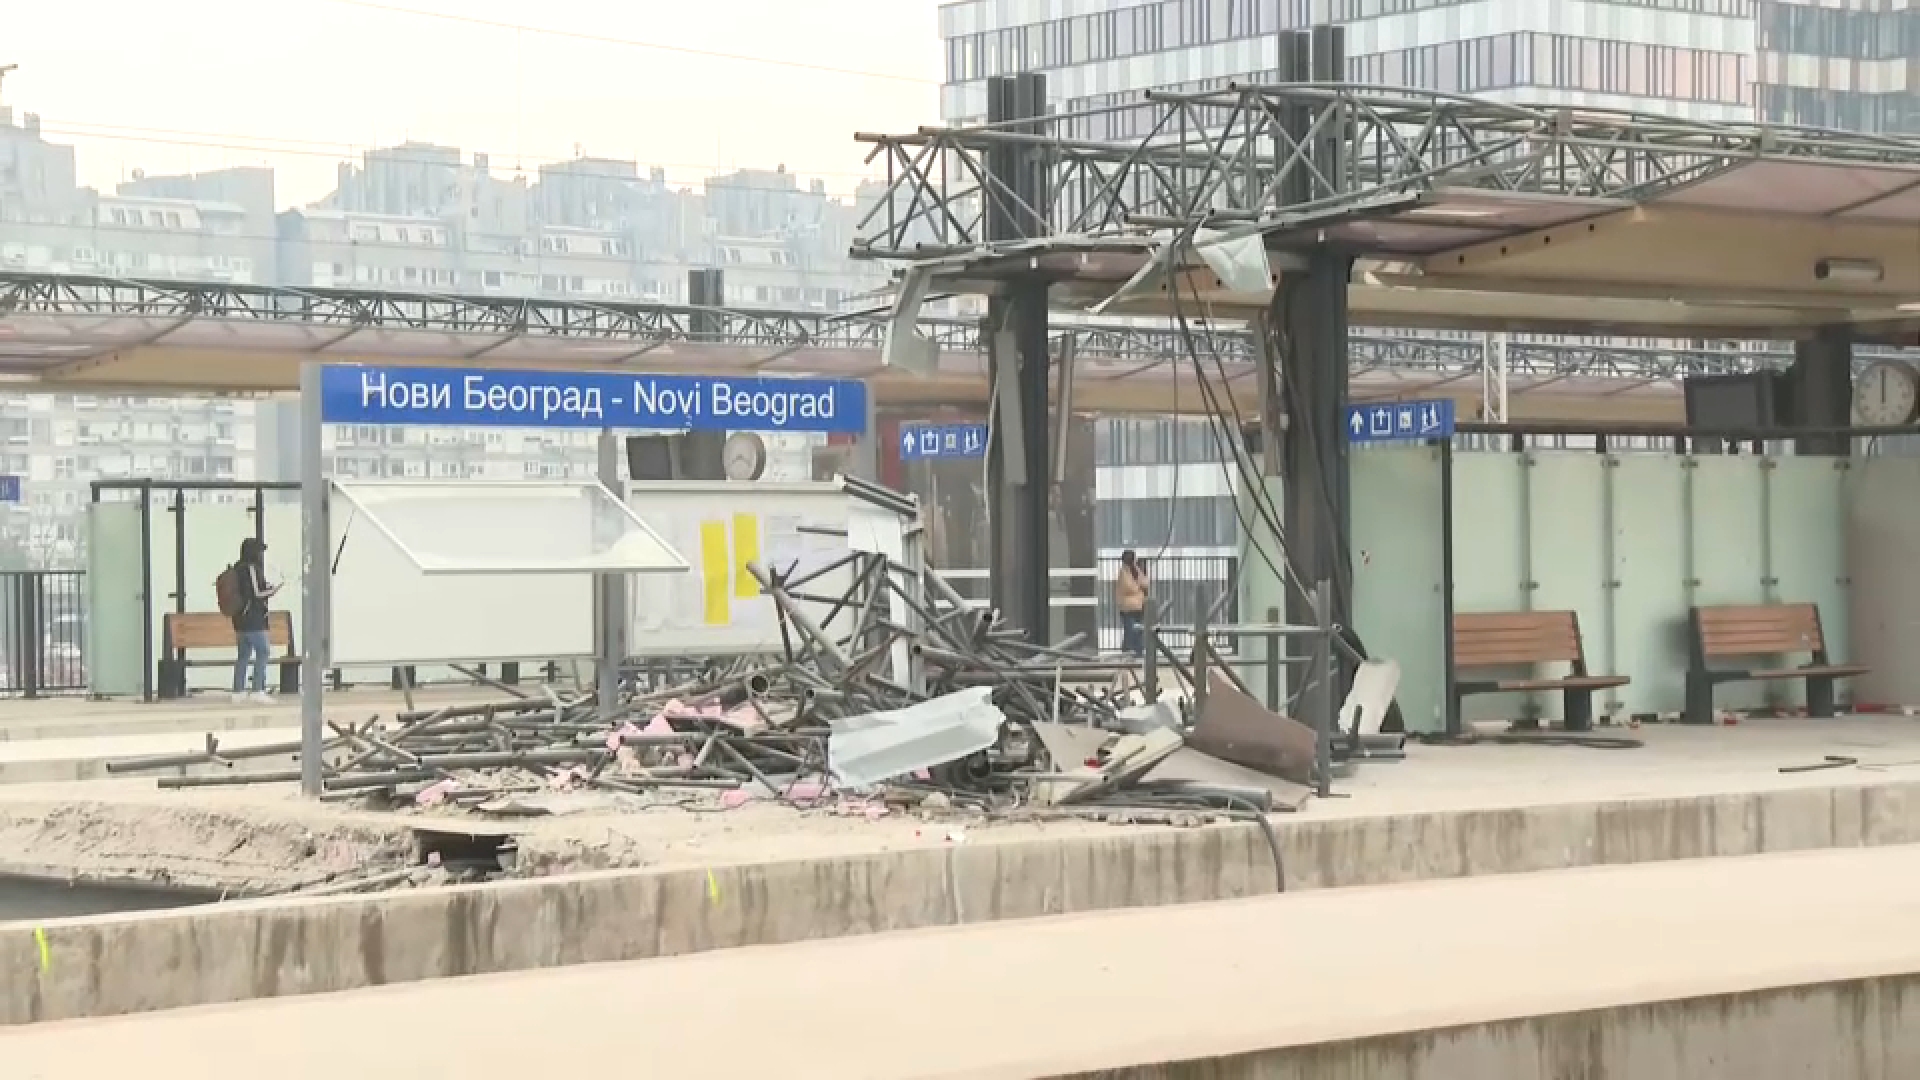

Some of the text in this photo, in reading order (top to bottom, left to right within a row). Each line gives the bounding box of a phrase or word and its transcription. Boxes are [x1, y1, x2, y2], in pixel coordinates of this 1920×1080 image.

[361, 372, 451, 408] Нови
[464, 376, 603, 419] Београд
[634, 381, 701, 416] Novi
[713, 383, 834, 425] Beograd
